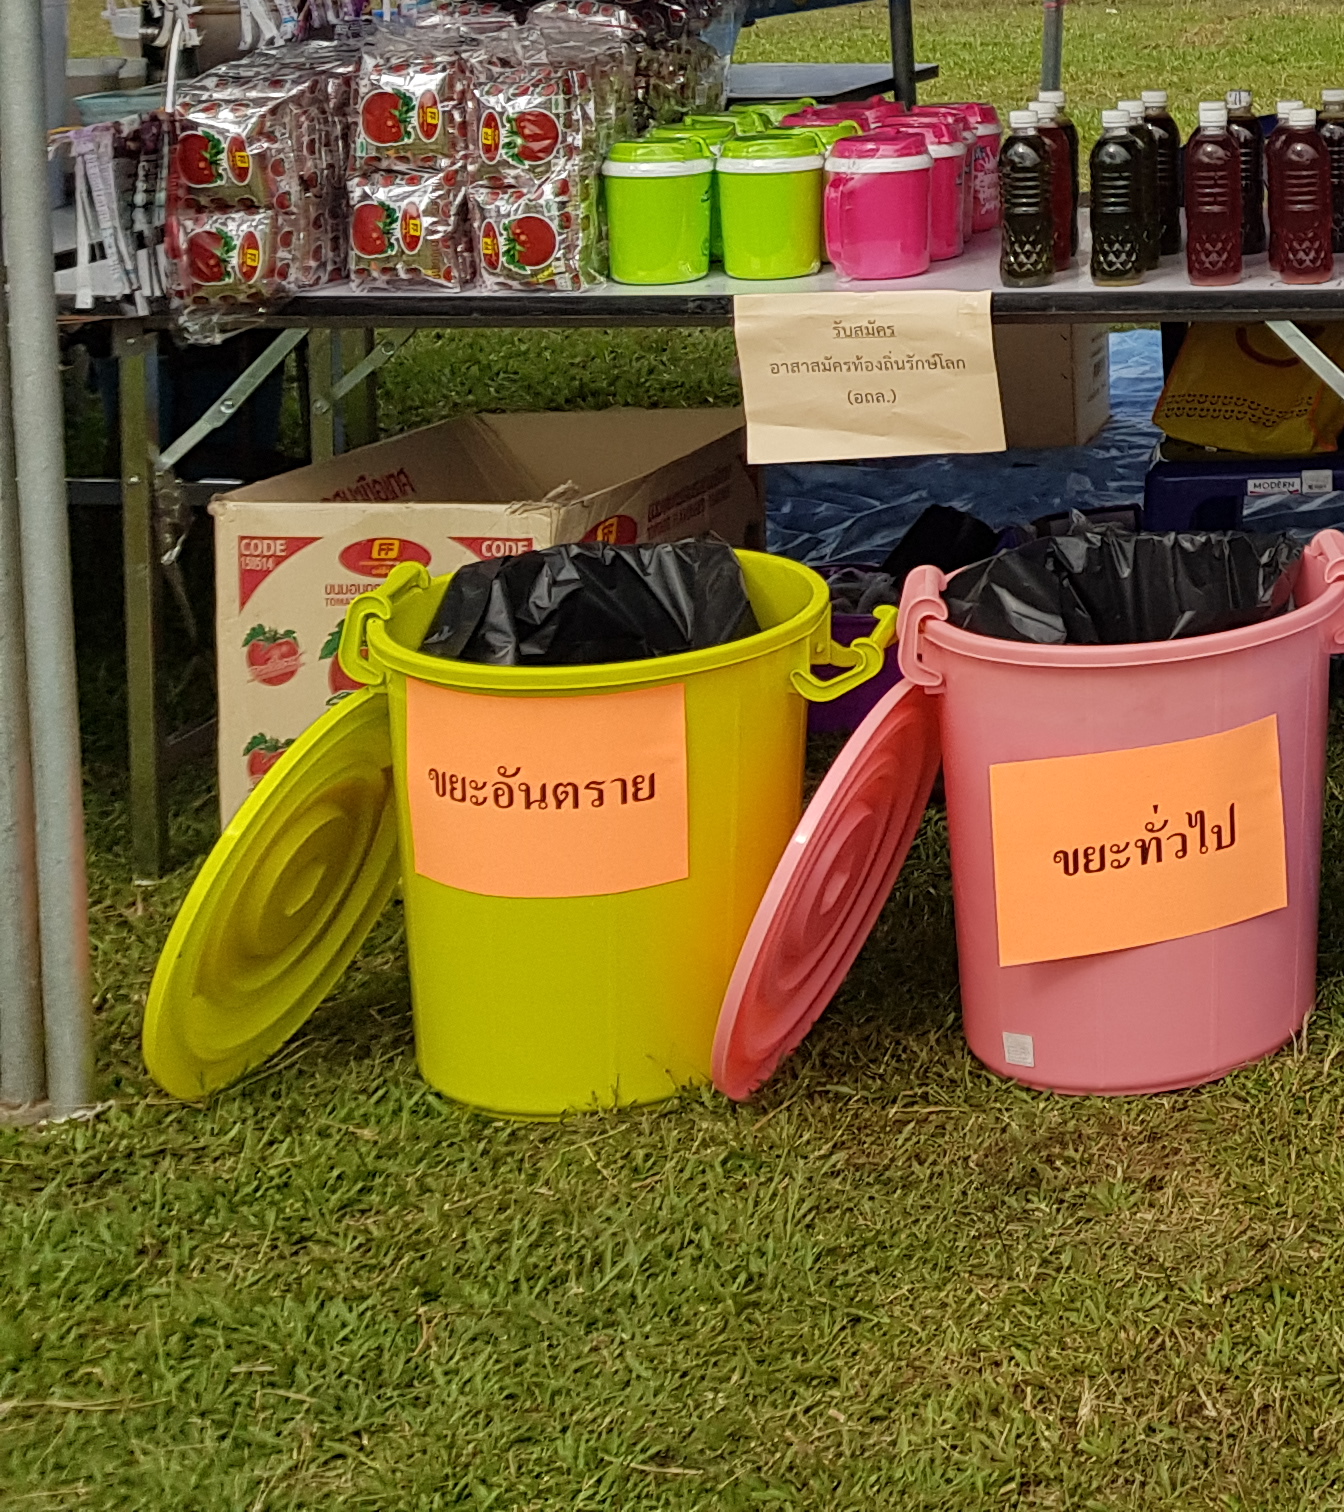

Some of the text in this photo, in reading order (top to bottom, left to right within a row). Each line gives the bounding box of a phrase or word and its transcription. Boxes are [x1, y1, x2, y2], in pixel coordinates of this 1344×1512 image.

[832, 319, 897, 339] รับสมัคร
[769, 351, 967, 375] อาสาสมัครท้องถิ่นรักษ์โลก
[846, 388, 898, 406] (อถล.)
[240, 539, 287, 556] CODE
[481, 540, 530, 557] CODE
[427, 764, 656, 811] ขยะอันตราย
[1053, 802, 1237, 877] ขยะทั่วไป
